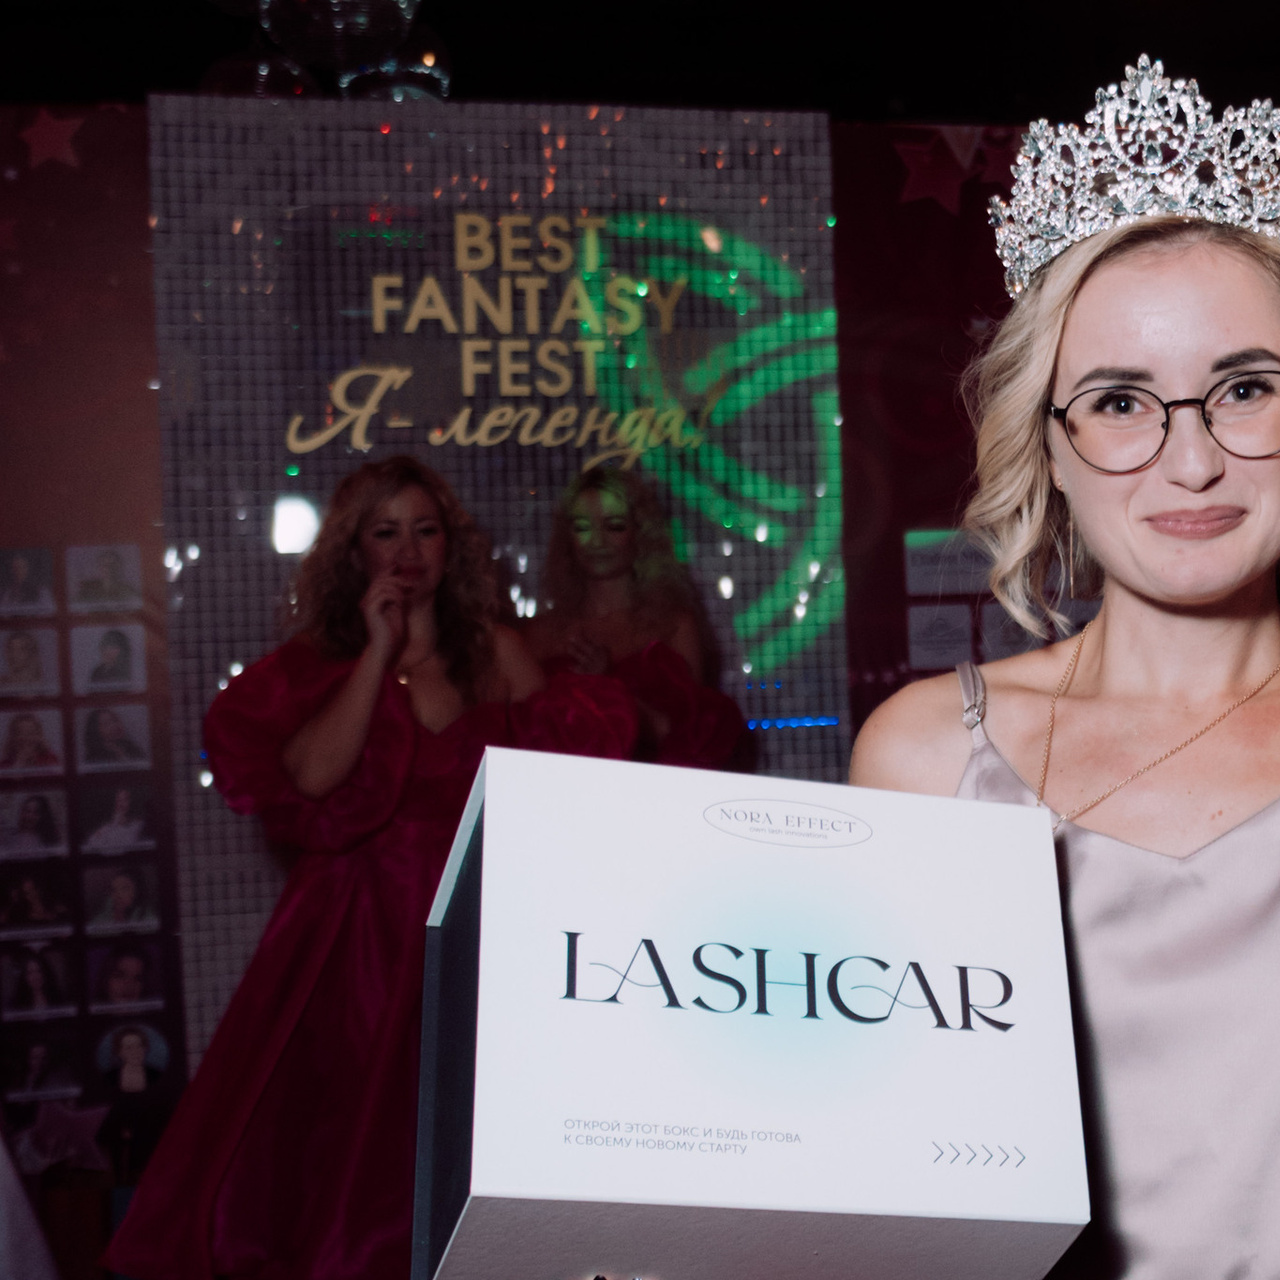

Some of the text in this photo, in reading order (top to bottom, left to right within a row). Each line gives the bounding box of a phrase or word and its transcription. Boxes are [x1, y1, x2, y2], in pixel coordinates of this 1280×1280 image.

[454, 213, 607, 273] BEST
[371, 275, 688, 336] FANTASY
[460, 339, 605, 397] FEST
[720, 807, 856, 833] NORA EFFECT
[748, 827, 829, 840] own lash innovations
[559, 930, 1016, 1033] LASHCAR
[563, 1116, 802, 1144] ОТКРОЙ ЭТОТ БОКС И БУДЬ ГОТОВА
[563, 1134, 748, 1156] К СВОЕМУ НОВОМУ СТАРТУ
